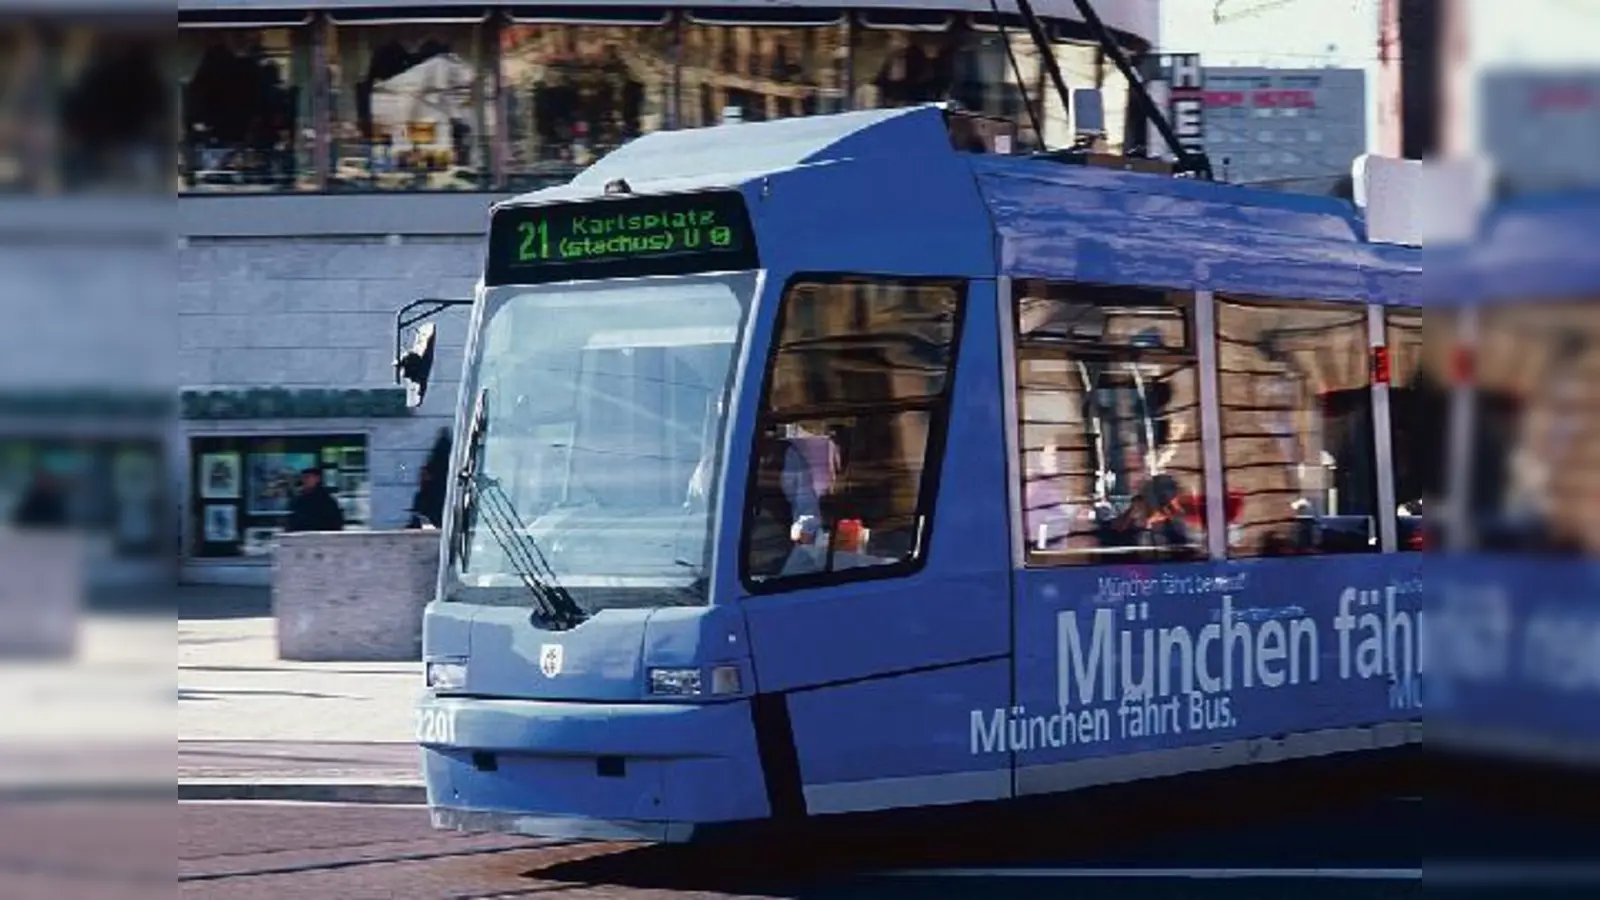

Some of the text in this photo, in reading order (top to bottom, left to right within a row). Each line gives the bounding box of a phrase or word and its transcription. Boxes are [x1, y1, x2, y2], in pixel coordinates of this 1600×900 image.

[518, 219, 548, 260] 21
[572, 209, 716, 235] Karlsplatz
[684, 228, 699, 248] U
[1056, 595, 1319, 706] München
[970, 691, 1237, 754] München fährt Bus.
